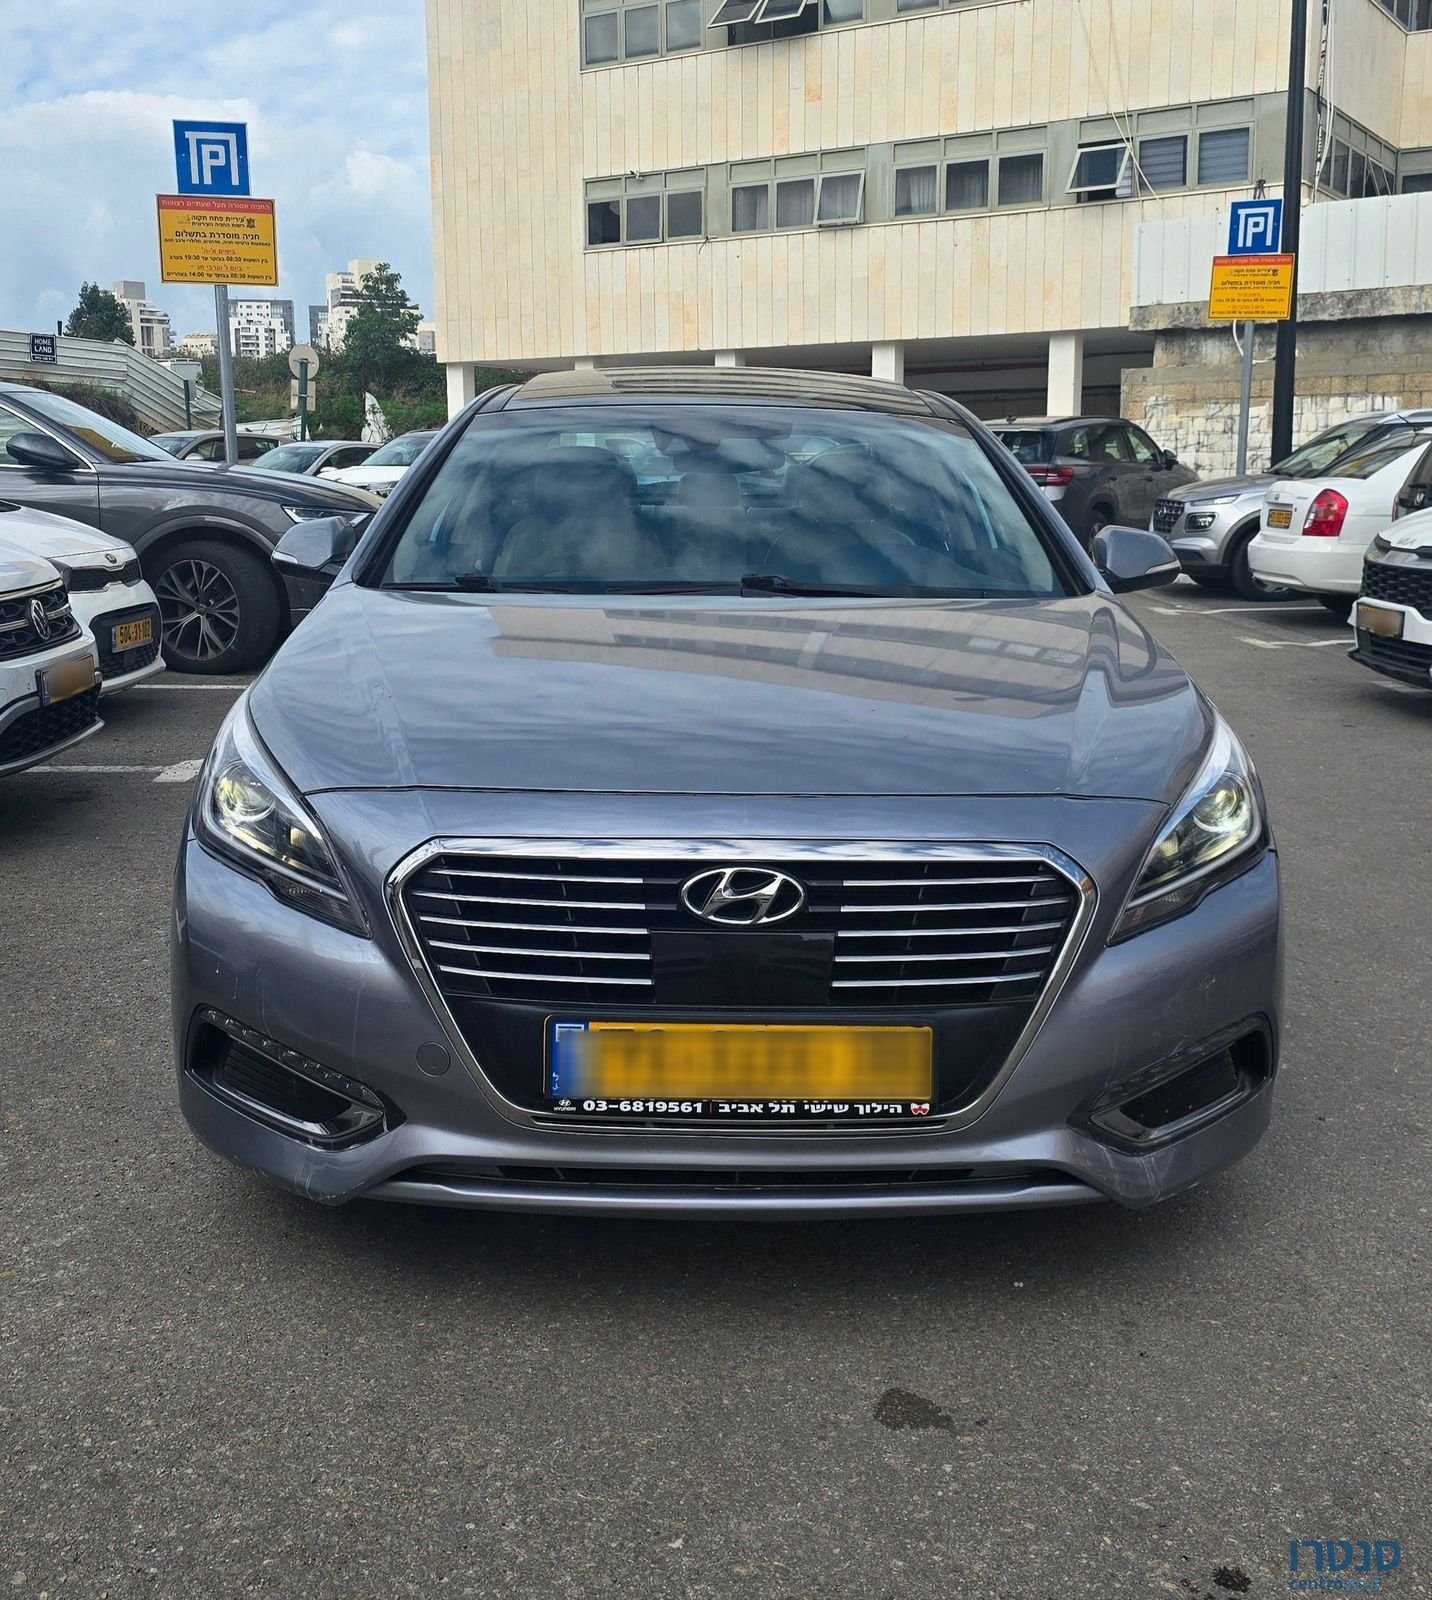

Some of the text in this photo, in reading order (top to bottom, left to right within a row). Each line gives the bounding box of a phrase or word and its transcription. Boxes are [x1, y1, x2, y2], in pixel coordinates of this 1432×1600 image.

[212, 200, 227, 209] מעל
[228, 202, 249, 210] אסורה
[249, 203, 271, 211] החניה
[191, 214, 208, 222] תקוה
[225, 215, 246, 223] עיריית
[175, 229, 260, 241] חניה מוסדרת בתשלום
[34, 345, 52, 353] LAND
[583, 1100, 702, 1113] 03-6819561
[718, 1102, 903, 1115] הילוך שישי תל אביב
